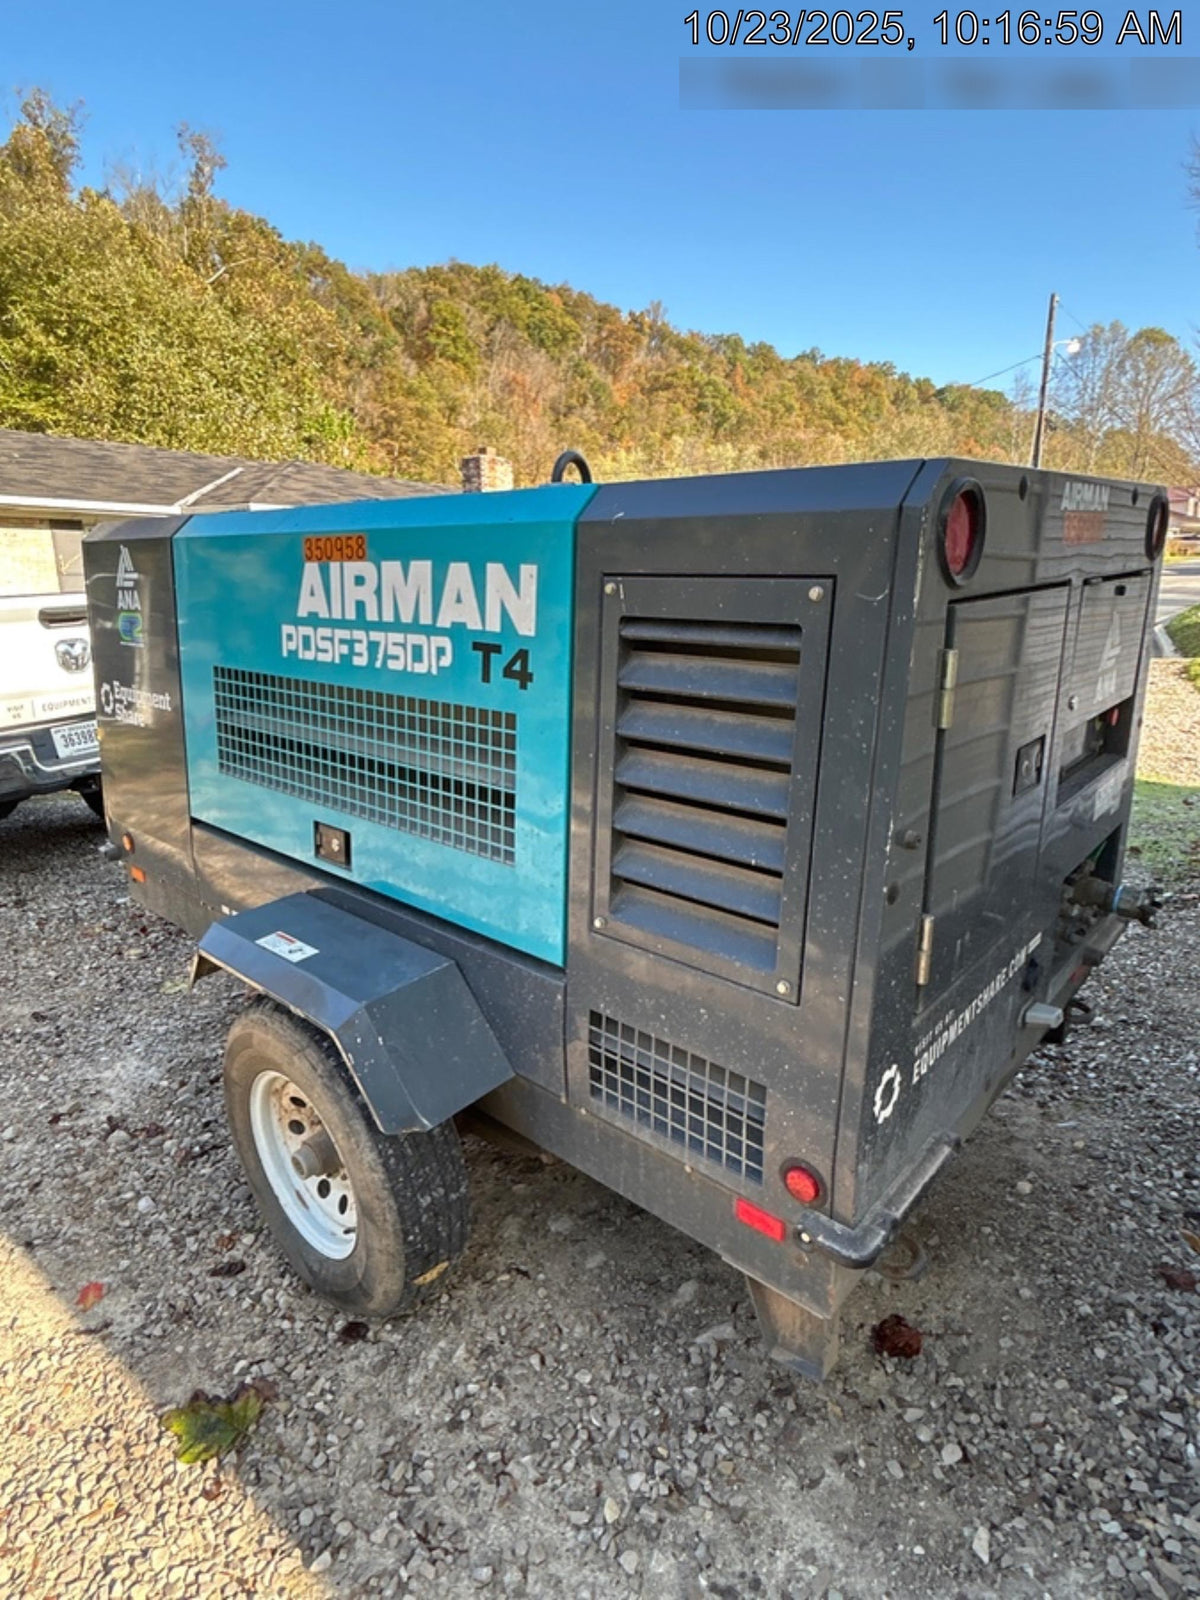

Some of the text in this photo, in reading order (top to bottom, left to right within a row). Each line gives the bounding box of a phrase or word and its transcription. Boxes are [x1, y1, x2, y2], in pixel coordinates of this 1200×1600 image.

[1061, 481, 1110, 511] AIRMAN
[304, 535, 366, 561] 350958
[117, 590, 141, 610] ANA
[297, 560, 538, 637] AIRMAN
[281, 624, 534, 690] PDSF375DP T4
[113, 680, 171, 712] Equipment
